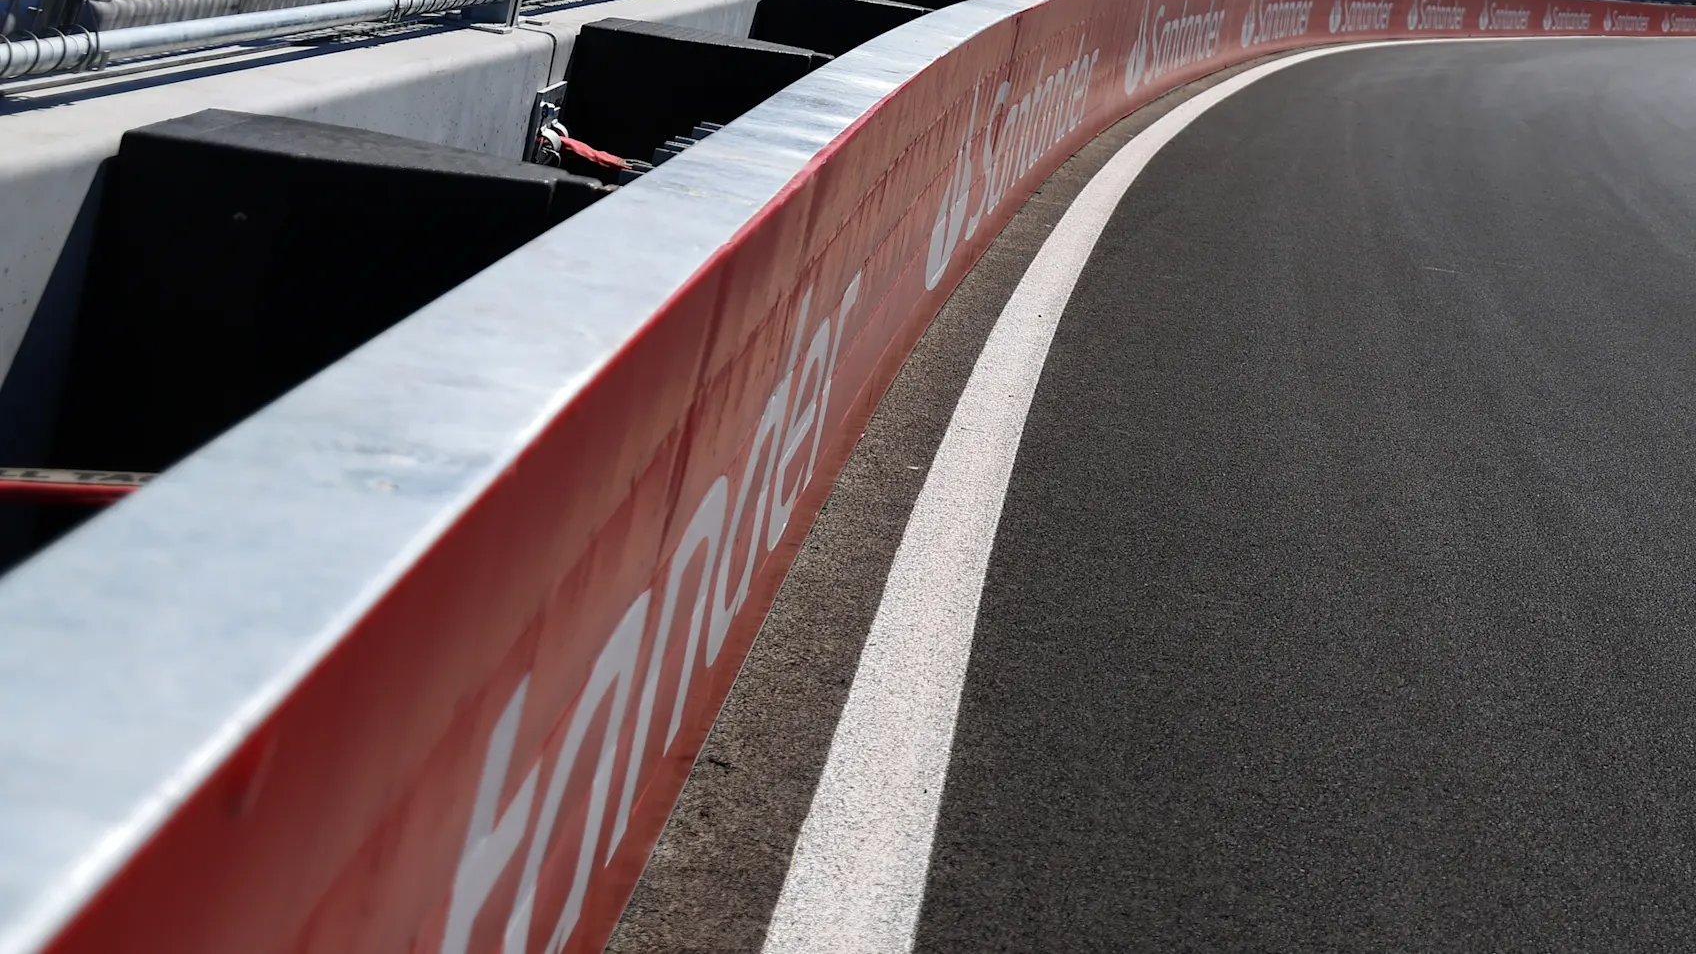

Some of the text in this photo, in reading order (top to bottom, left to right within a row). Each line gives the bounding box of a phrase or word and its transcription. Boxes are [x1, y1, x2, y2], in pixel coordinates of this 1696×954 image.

[1489, 1, 1531, 30] Santander
[1550, 5, 1592, 30] Santander
[1612, 9, 1650, 31] Santander
[965, 33, 1099, 240] Santander
